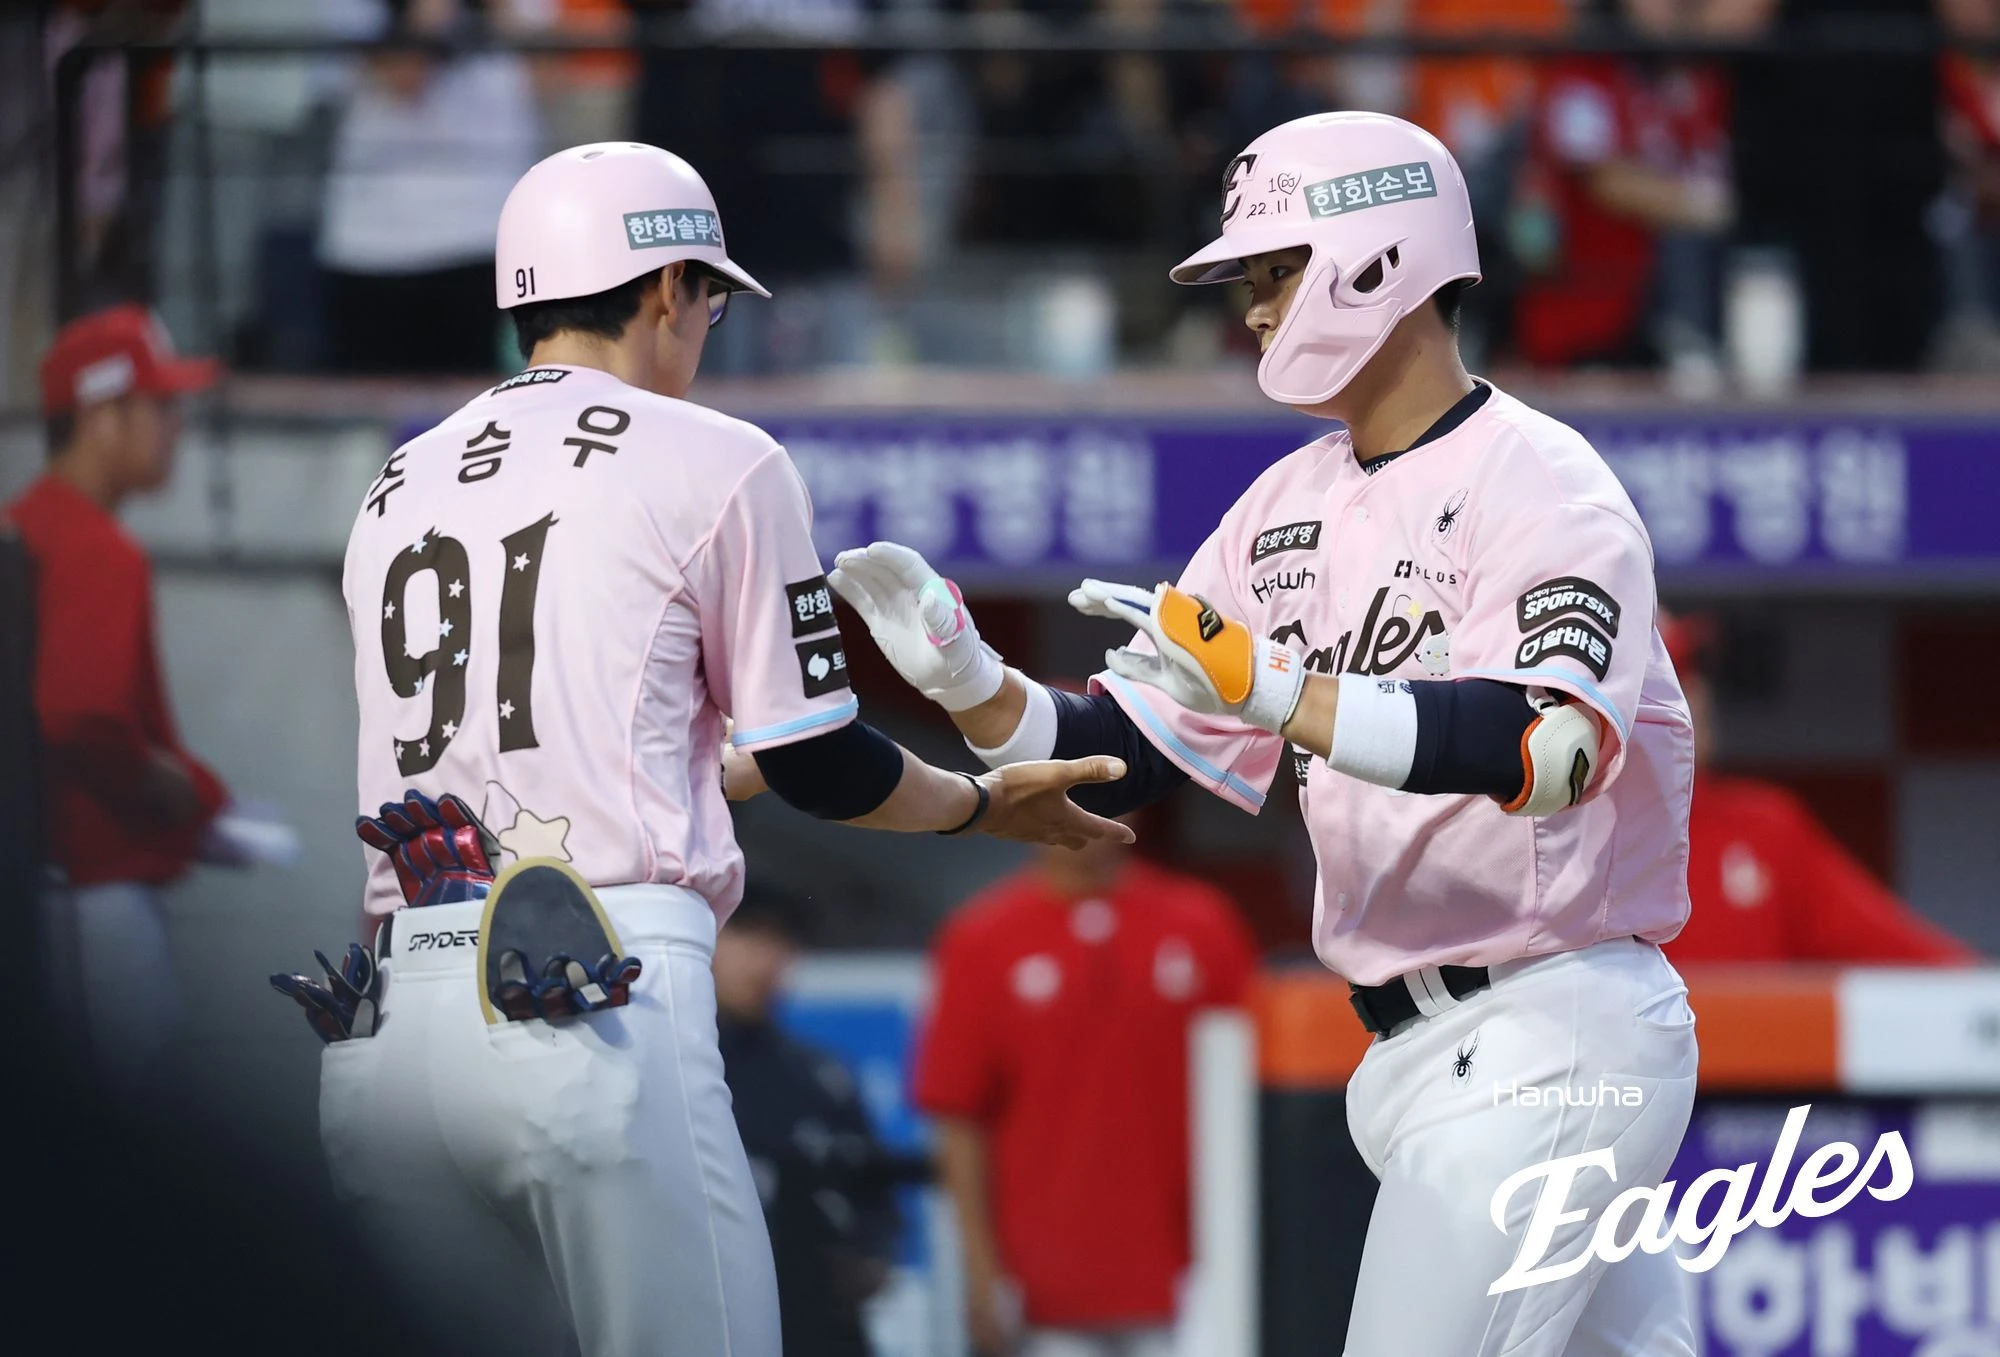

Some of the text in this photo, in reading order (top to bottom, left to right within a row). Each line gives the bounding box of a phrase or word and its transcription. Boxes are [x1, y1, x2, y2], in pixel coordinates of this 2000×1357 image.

[1309, 166, 1433, 216] 한화손보
[1246, 198, 1289, 219] 22.11
[627, 213, 721, 244] 한화솔루션
[515, 267, 537, 298] 91
[1255, 524, 1316, 555] 한화생명
[1523, 591, 1615, 625] SPORTSIX
[381, 510, 560, 777] 91
